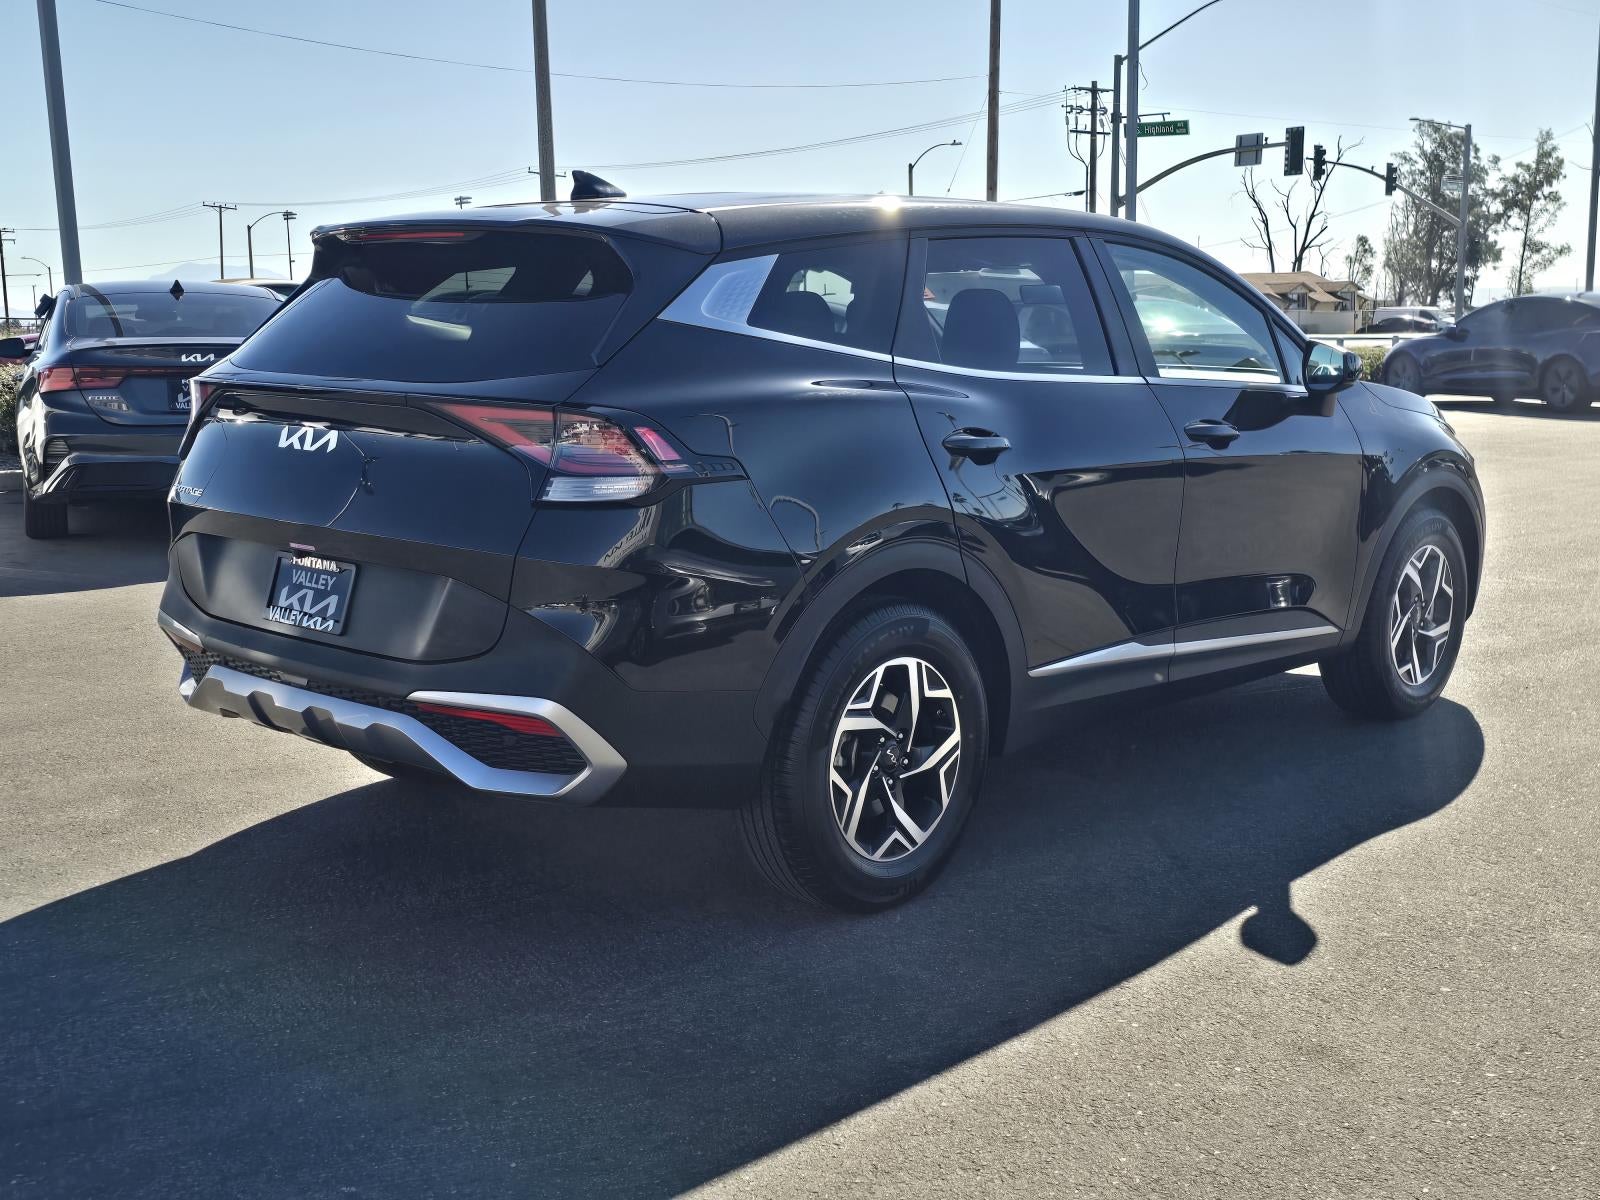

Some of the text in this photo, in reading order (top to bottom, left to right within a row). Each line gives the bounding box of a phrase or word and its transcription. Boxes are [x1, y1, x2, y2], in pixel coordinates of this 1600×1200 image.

[1144, 124, 1174, 135] Highland
[181, 353, 215, 362] KIA
[278, 425, 339, 453] KIA
[292, 556, 338, 572] FONTANA
[292, 569, 337, 591] VALLEY
[278, 585, 339, 617] KIA
[269, 605, 335, 632] VALLEY KIA
